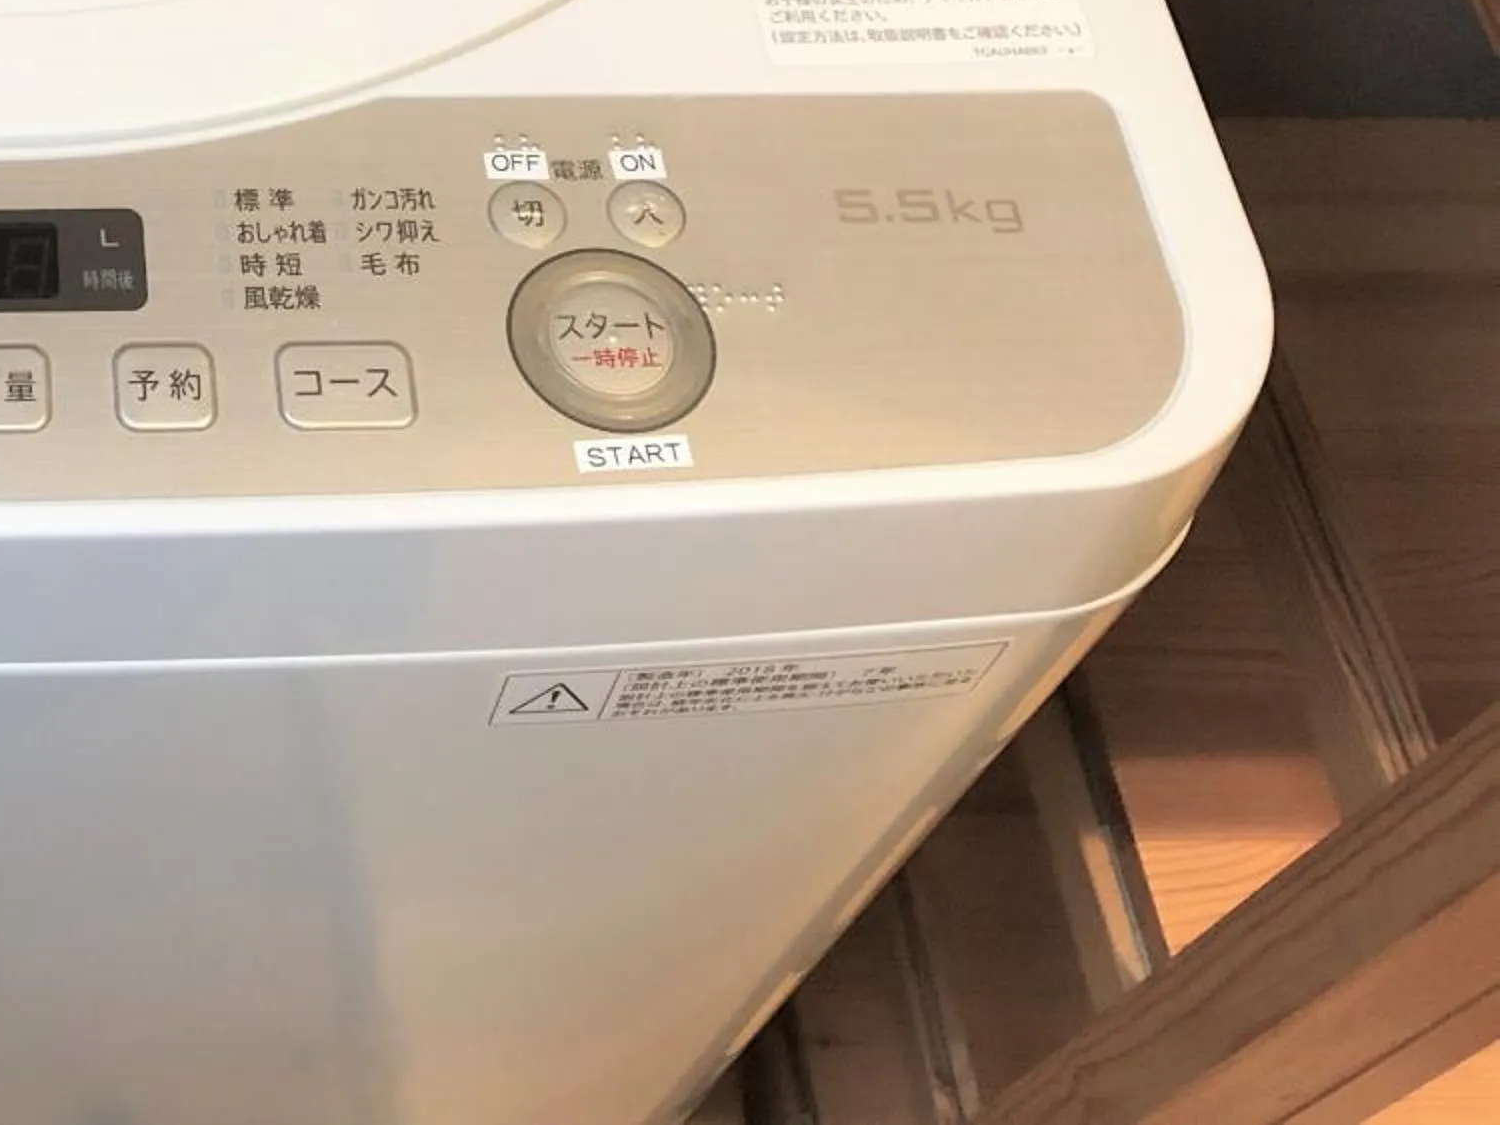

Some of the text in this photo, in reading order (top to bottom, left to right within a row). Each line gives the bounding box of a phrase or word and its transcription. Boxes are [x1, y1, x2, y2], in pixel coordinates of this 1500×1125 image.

[491, 154, 541, 172] OFF
[551, 158, 604, 181] 電源
[619, 154, 658, 172] ON
[233, 187, 295, 211] 標準
[351, 187, 436, 211] ガンコ汚れ
[832, 188, 1026, 234] 5.5kg
[512, 199, 546, 228] 切
[100, 228, 120, 248] L
[236, 220, 328, 244] おしゃれ着
[355, 219, 441, 244] シワ抑え
[240, 253, 304, 276] 時短
[360, 252, 420, 276] 毛布
[83, 270, 136, 292] 時間後
[244, 285, 322, 311] 風乾燥
[555, 312, 667, 341] スタート
[571, 347, 663, 370] 一時停止
[128, 369, 202, 401] 予約
[293, 367, 399, 398] コース
[587, 442, 682, 469] START
